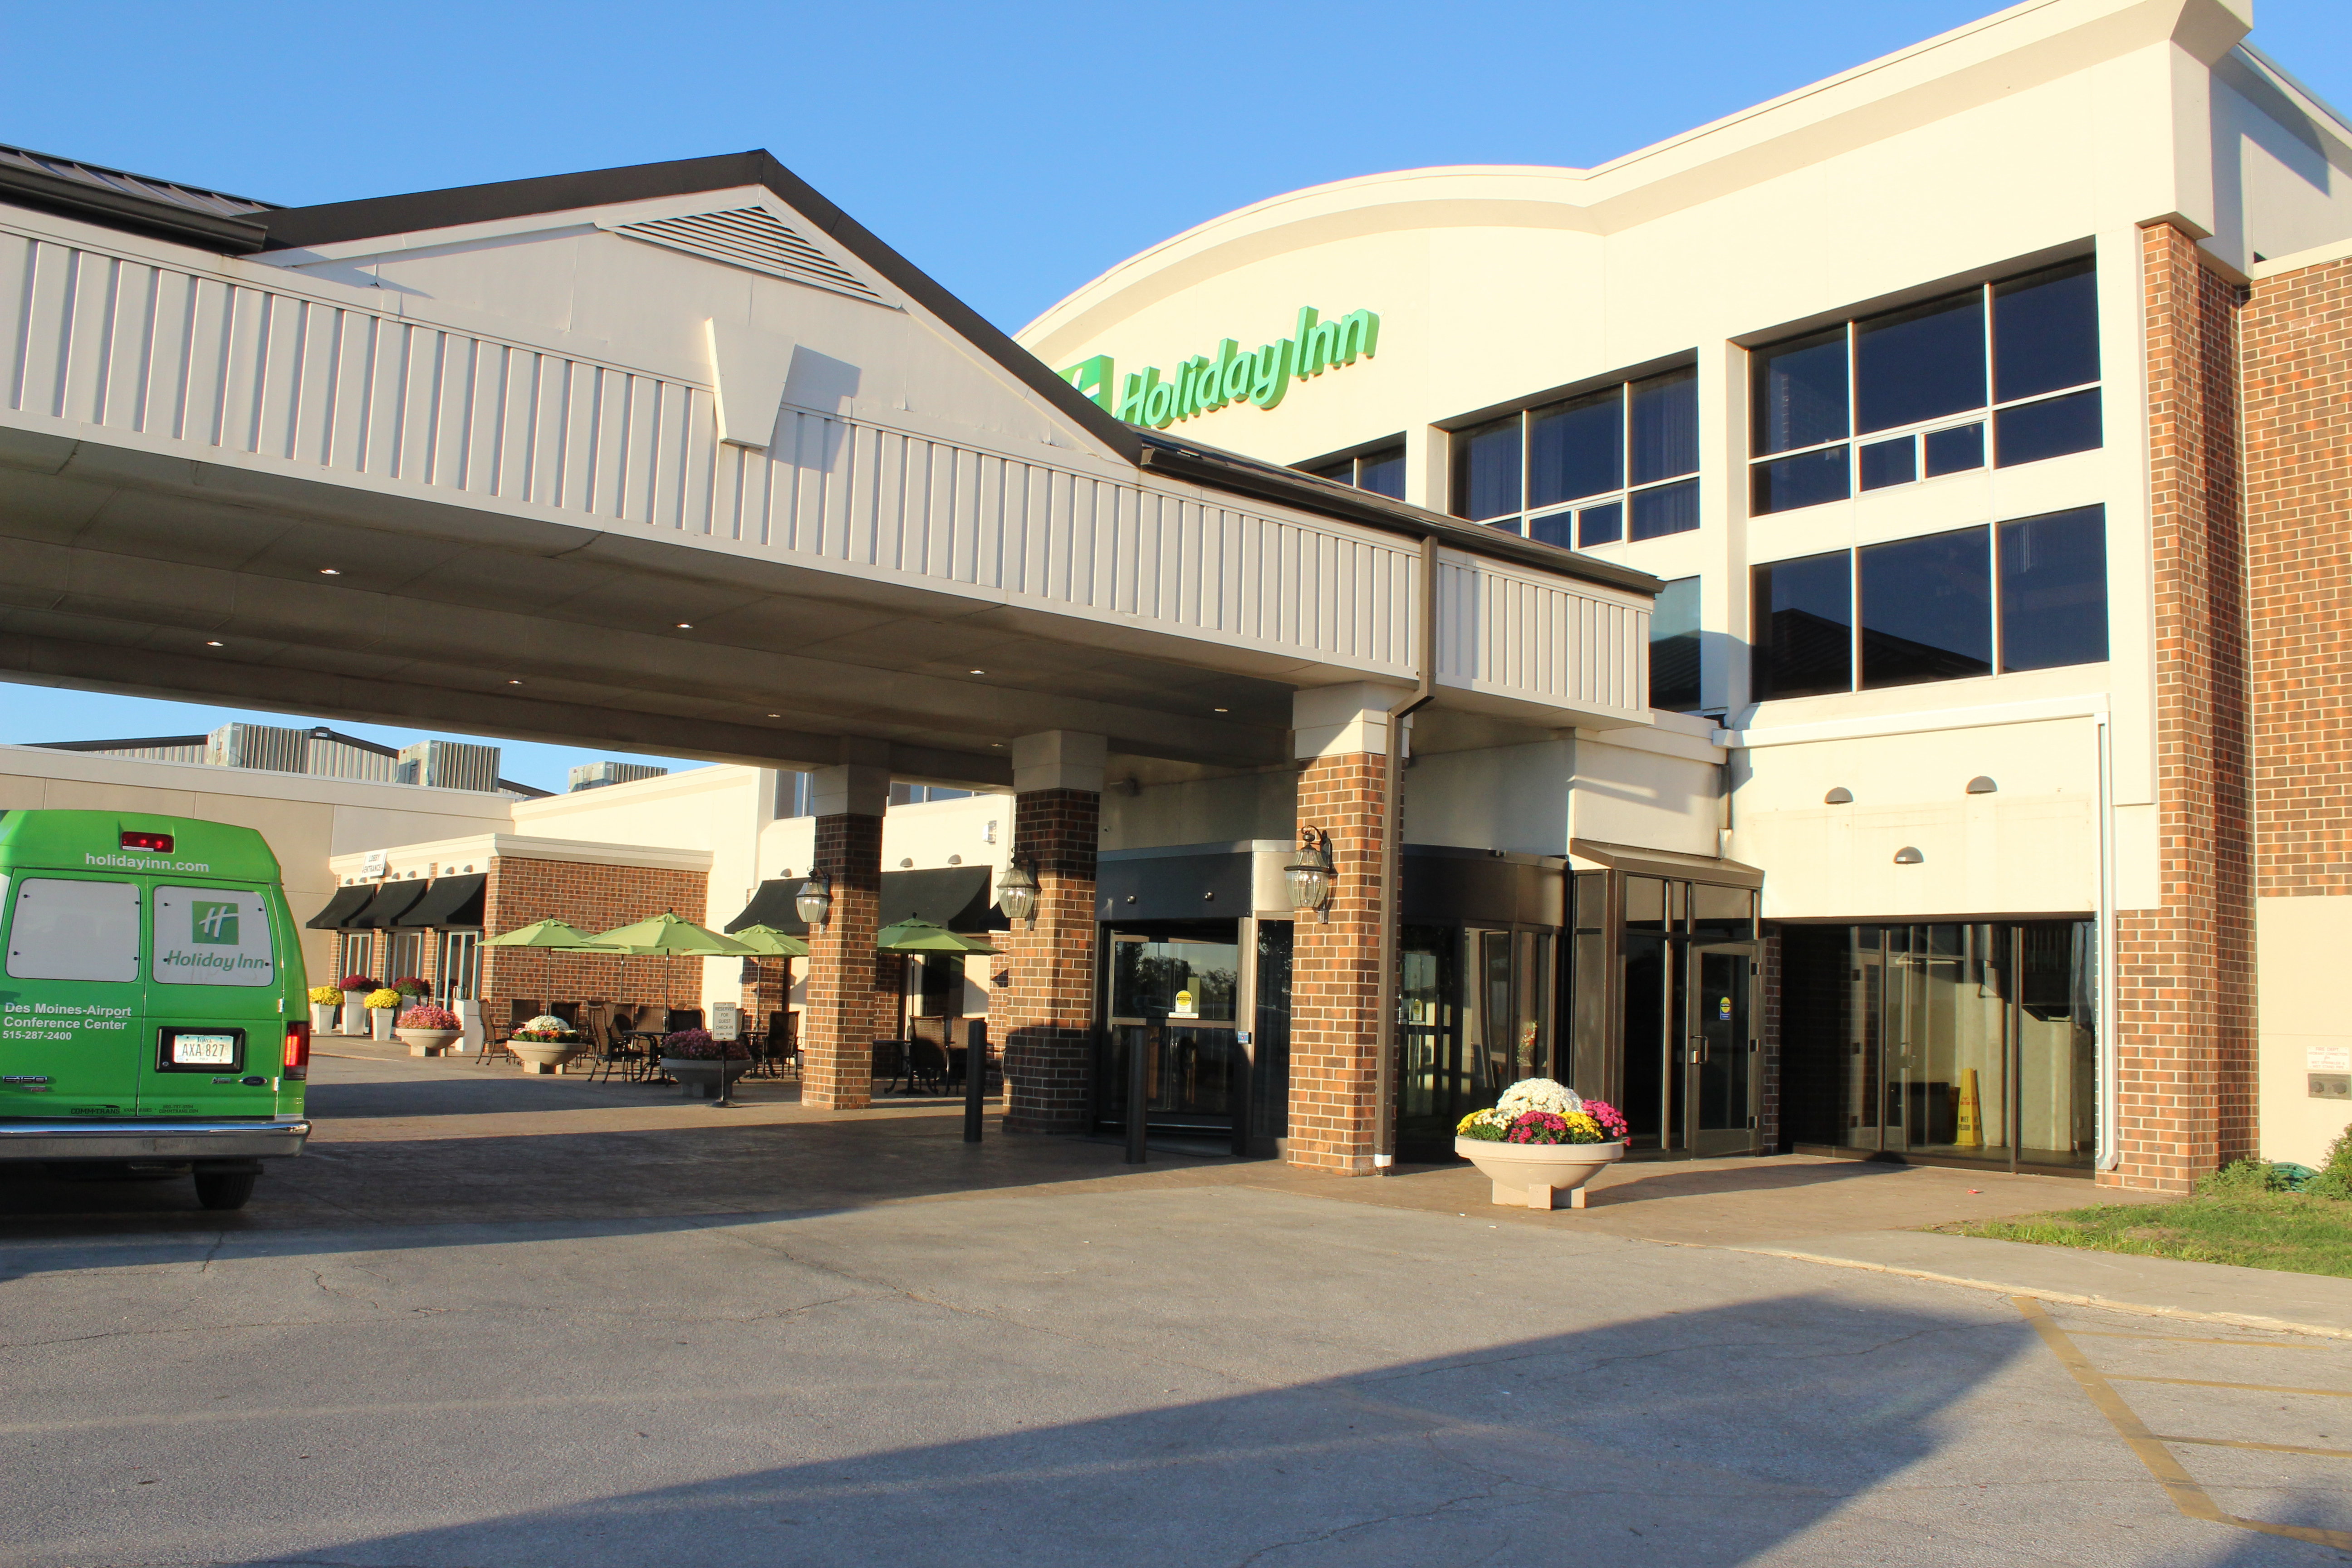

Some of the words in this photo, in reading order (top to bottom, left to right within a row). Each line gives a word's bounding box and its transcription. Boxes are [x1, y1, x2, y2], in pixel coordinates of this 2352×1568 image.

[1113, 338, 1294, 429] Holiday
[1291, 305, 1380, 381] Inn
[85, 853, 209, 872] holidayinn.com
[368, 854, 381, 862] LOBBY
[364, 864, 382, 873] ENTRANCE
[167, 950, 235, 971] Holiday
[238, 953, 265, 968] Inn
[5, 1002, 30, 1013] Des
[35, 1003, 132, 1018] Moines-Airport
[4, 1016, 81, 1029] Conference
[84, 1019, 127, 1030] Center
[2, 1030, 72, 1040] 515-287-2400
[182, 1043, 202, 1056] AXA
[206, 1044, 225, 1057] 827
